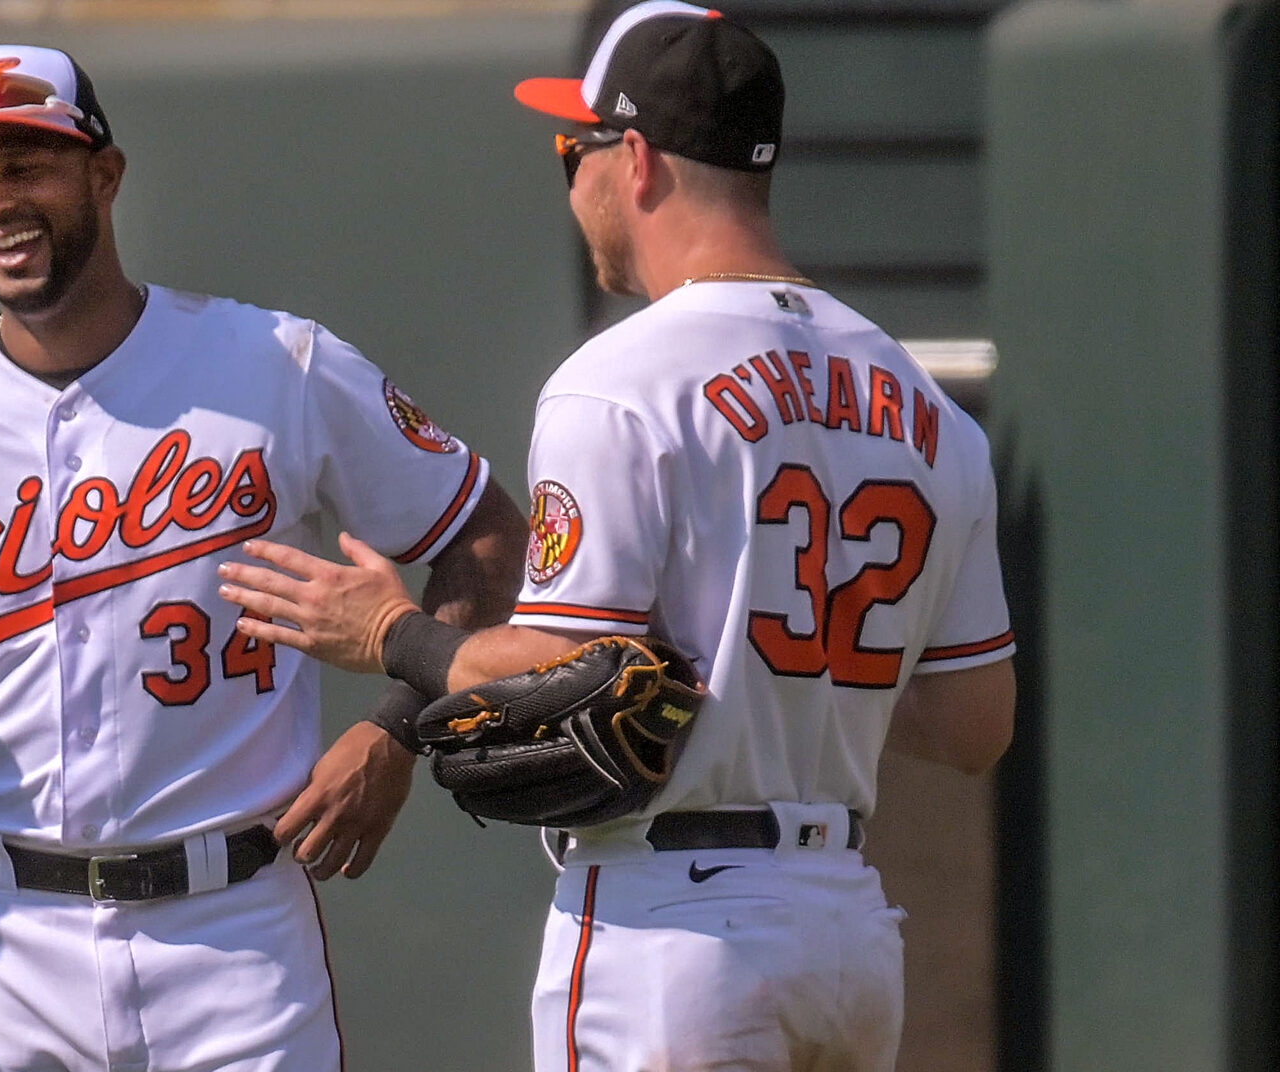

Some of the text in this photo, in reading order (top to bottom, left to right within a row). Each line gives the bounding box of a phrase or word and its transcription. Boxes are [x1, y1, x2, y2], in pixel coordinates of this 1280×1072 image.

[703, 349, 940, 470] O'HEARN
[746, 461, 938, 690] 32
[139, 600, 277, 706] 34
